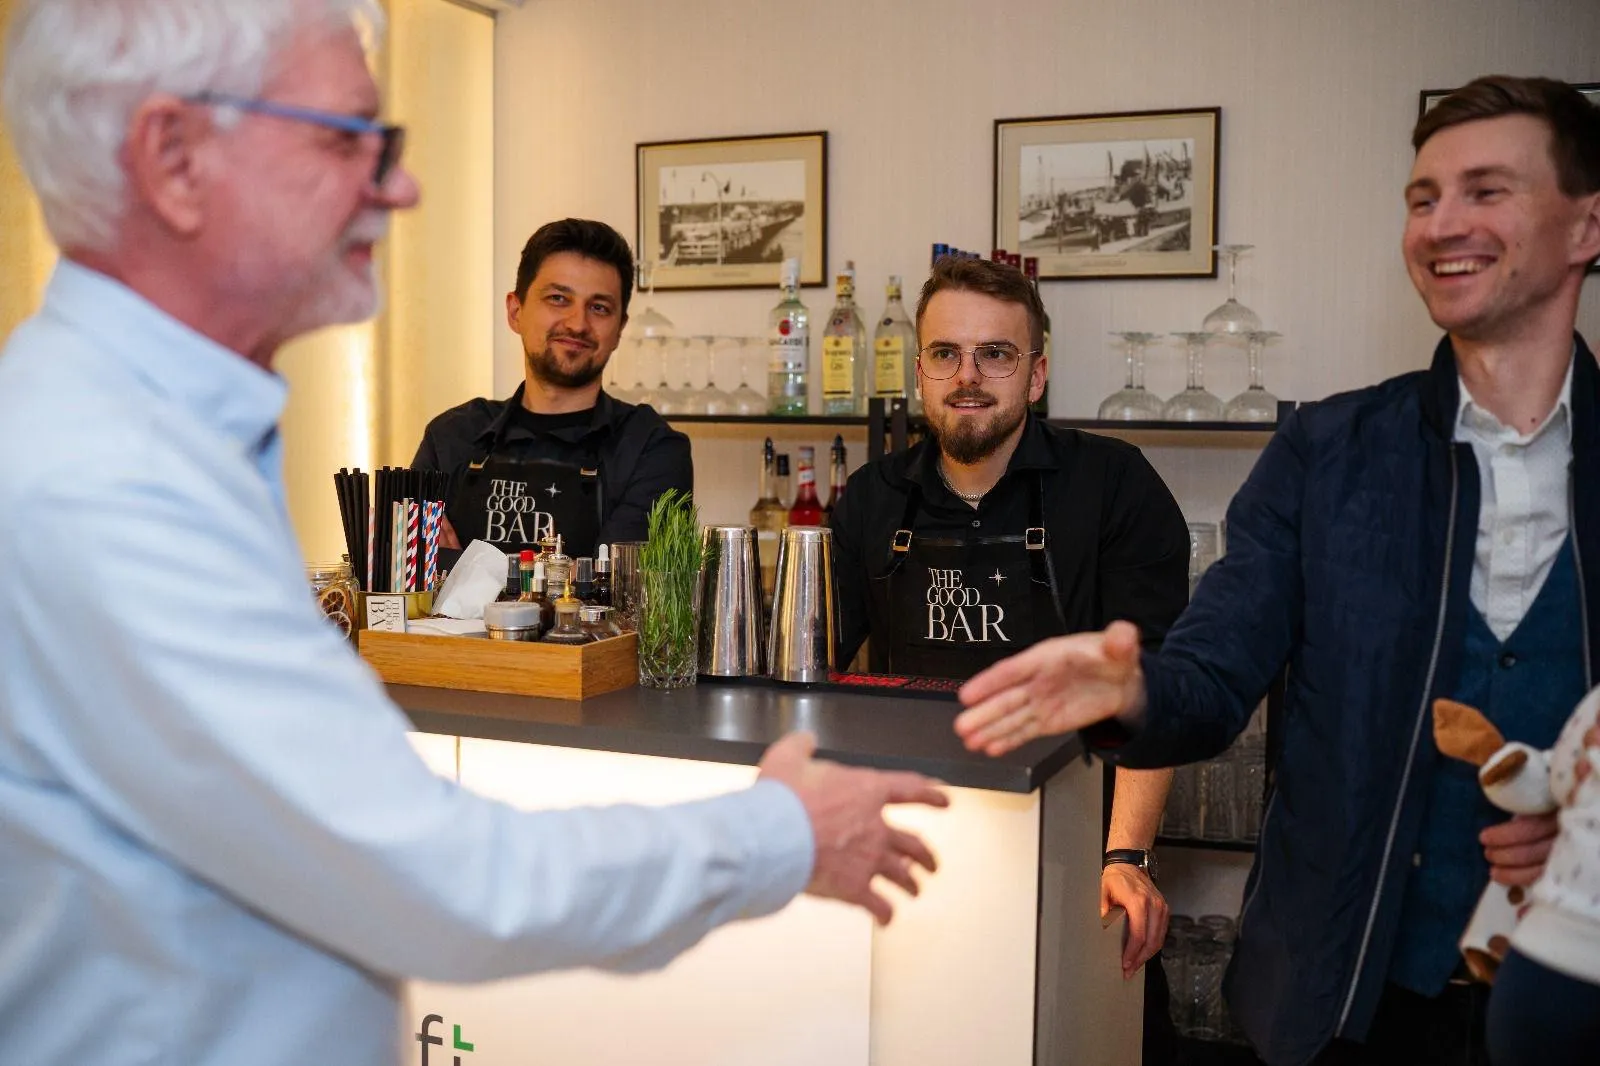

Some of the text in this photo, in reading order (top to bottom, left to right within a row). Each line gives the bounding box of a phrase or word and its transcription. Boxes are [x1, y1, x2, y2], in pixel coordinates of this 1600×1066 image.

[491, 479, 528, 497] THE
[486, 495, 536, 513] GOOD
[483, 510, 565, 544] BAR
[928, 567, 963, 589] THE
[927, 586, 980, 607] GOOD
[371, 600, 386, 630] BA
[924, 604, 1011, 642] BAR
